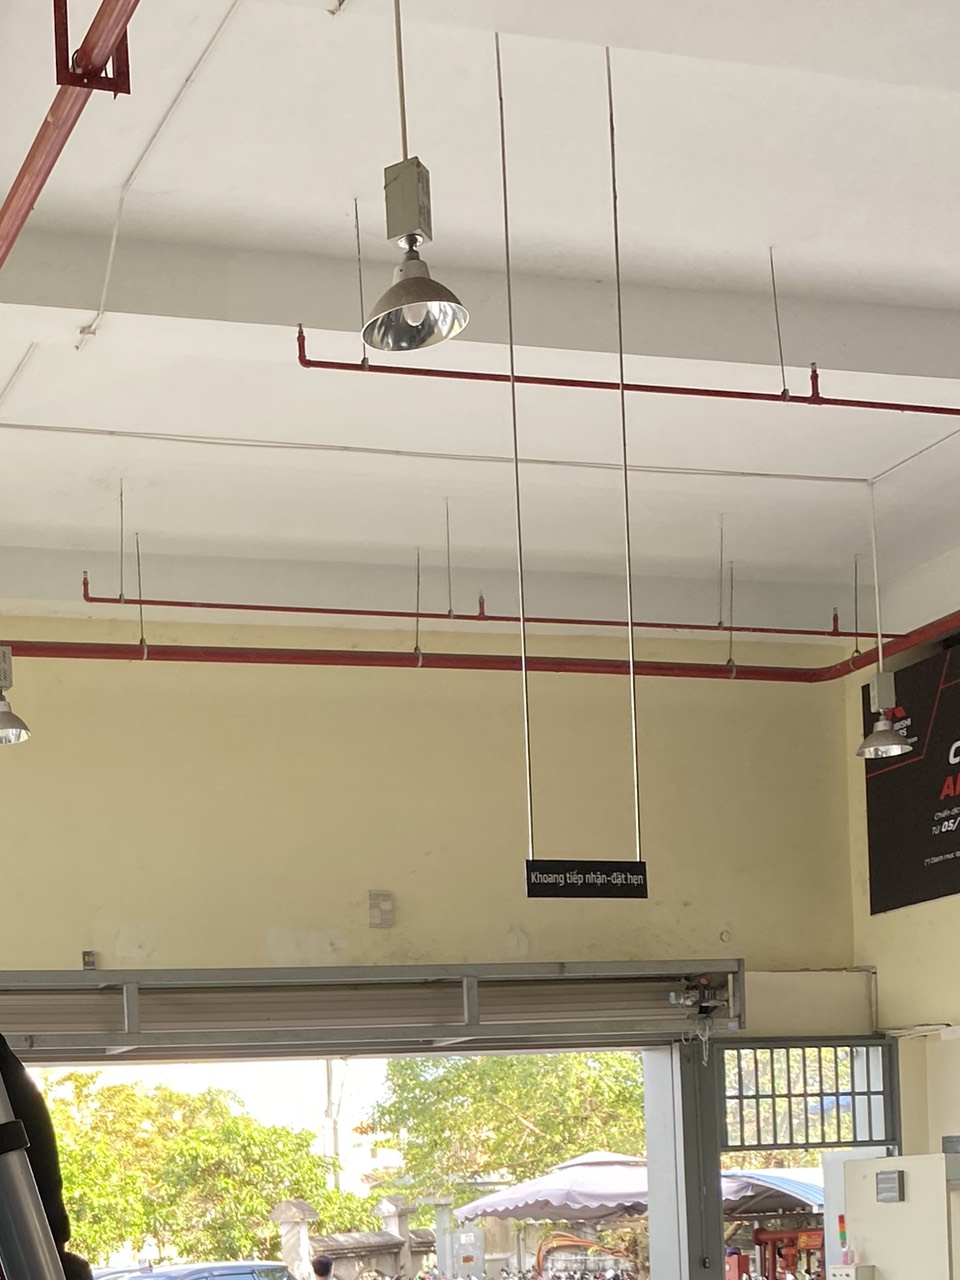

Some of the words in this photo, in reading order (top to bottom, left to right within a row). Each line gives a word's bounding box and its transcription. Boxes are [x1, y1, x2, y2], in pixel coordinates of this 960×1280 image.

[530, 871, 565, 887] Khoang
[566, 869, 584, 887] tiếp
[627, 872, 644, 887] hẹn
